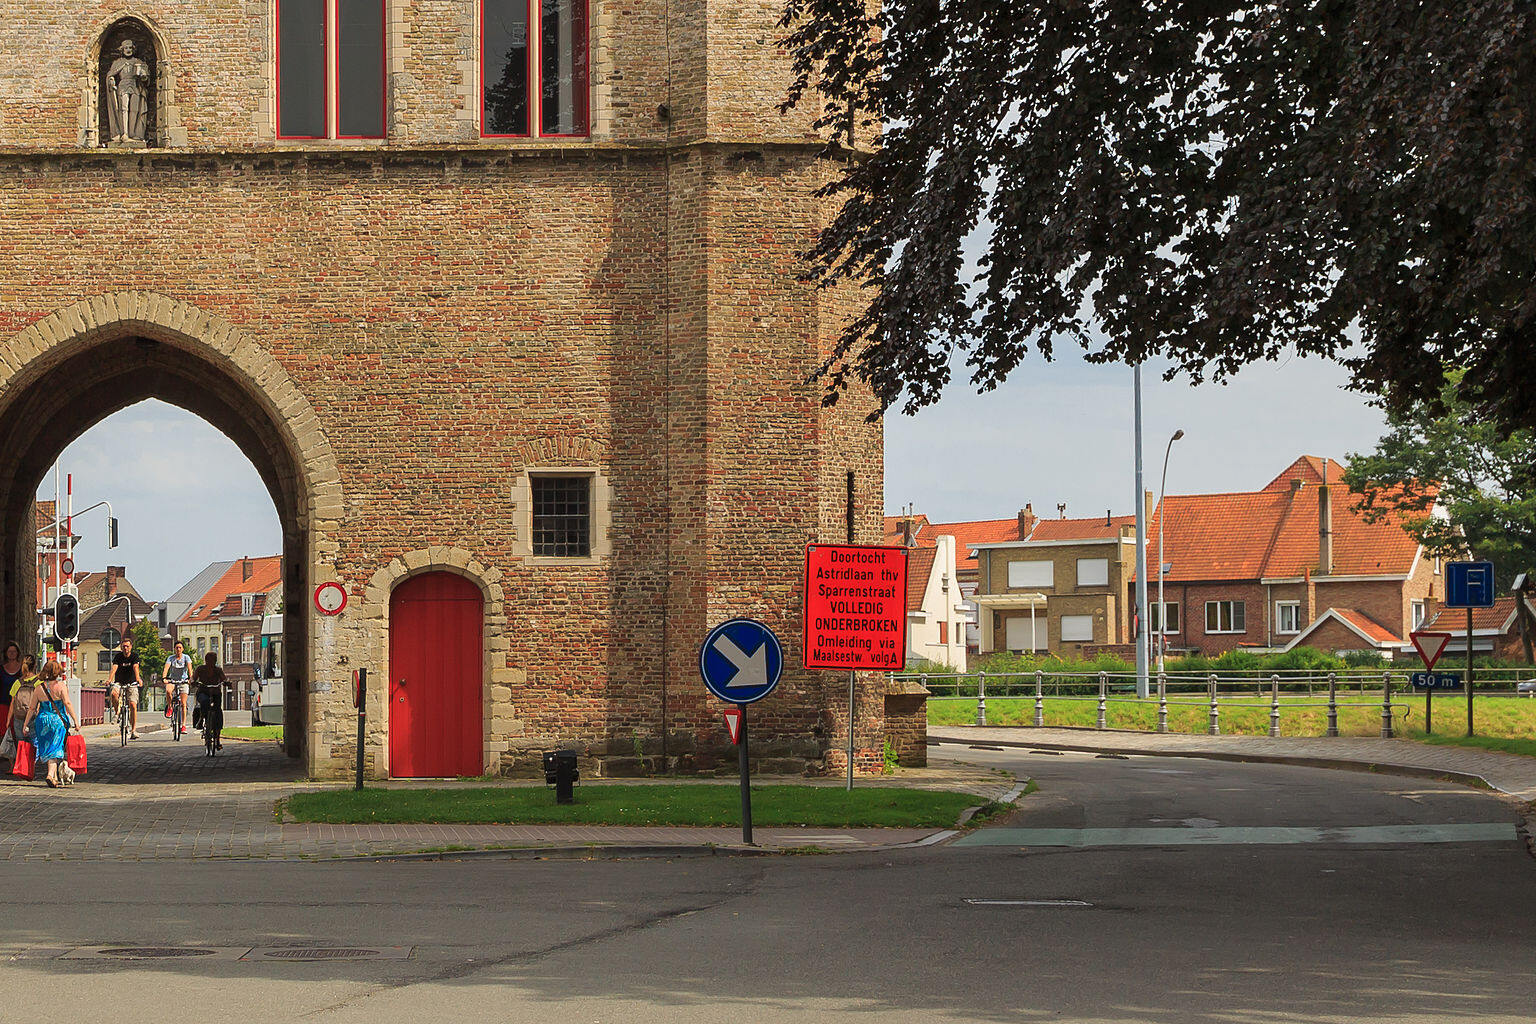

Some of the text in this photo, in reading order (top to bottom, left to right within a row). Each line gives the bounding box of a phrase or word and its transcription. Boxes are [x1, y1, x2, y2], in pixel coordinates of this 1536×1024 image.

[831, 550, 886, 564] Doortocht
[816, 567, 899, 581] Astridlaan thv
[818, 584, 896, 599] Sparrenstraat
[830, 601, 883, 615] VOLLEDIG
[815, 617, 898, 632] ONDERBROKEN
[817, 634, 895, 652] Omleiding via
[1418, 674, 1453, 687] 50 m
